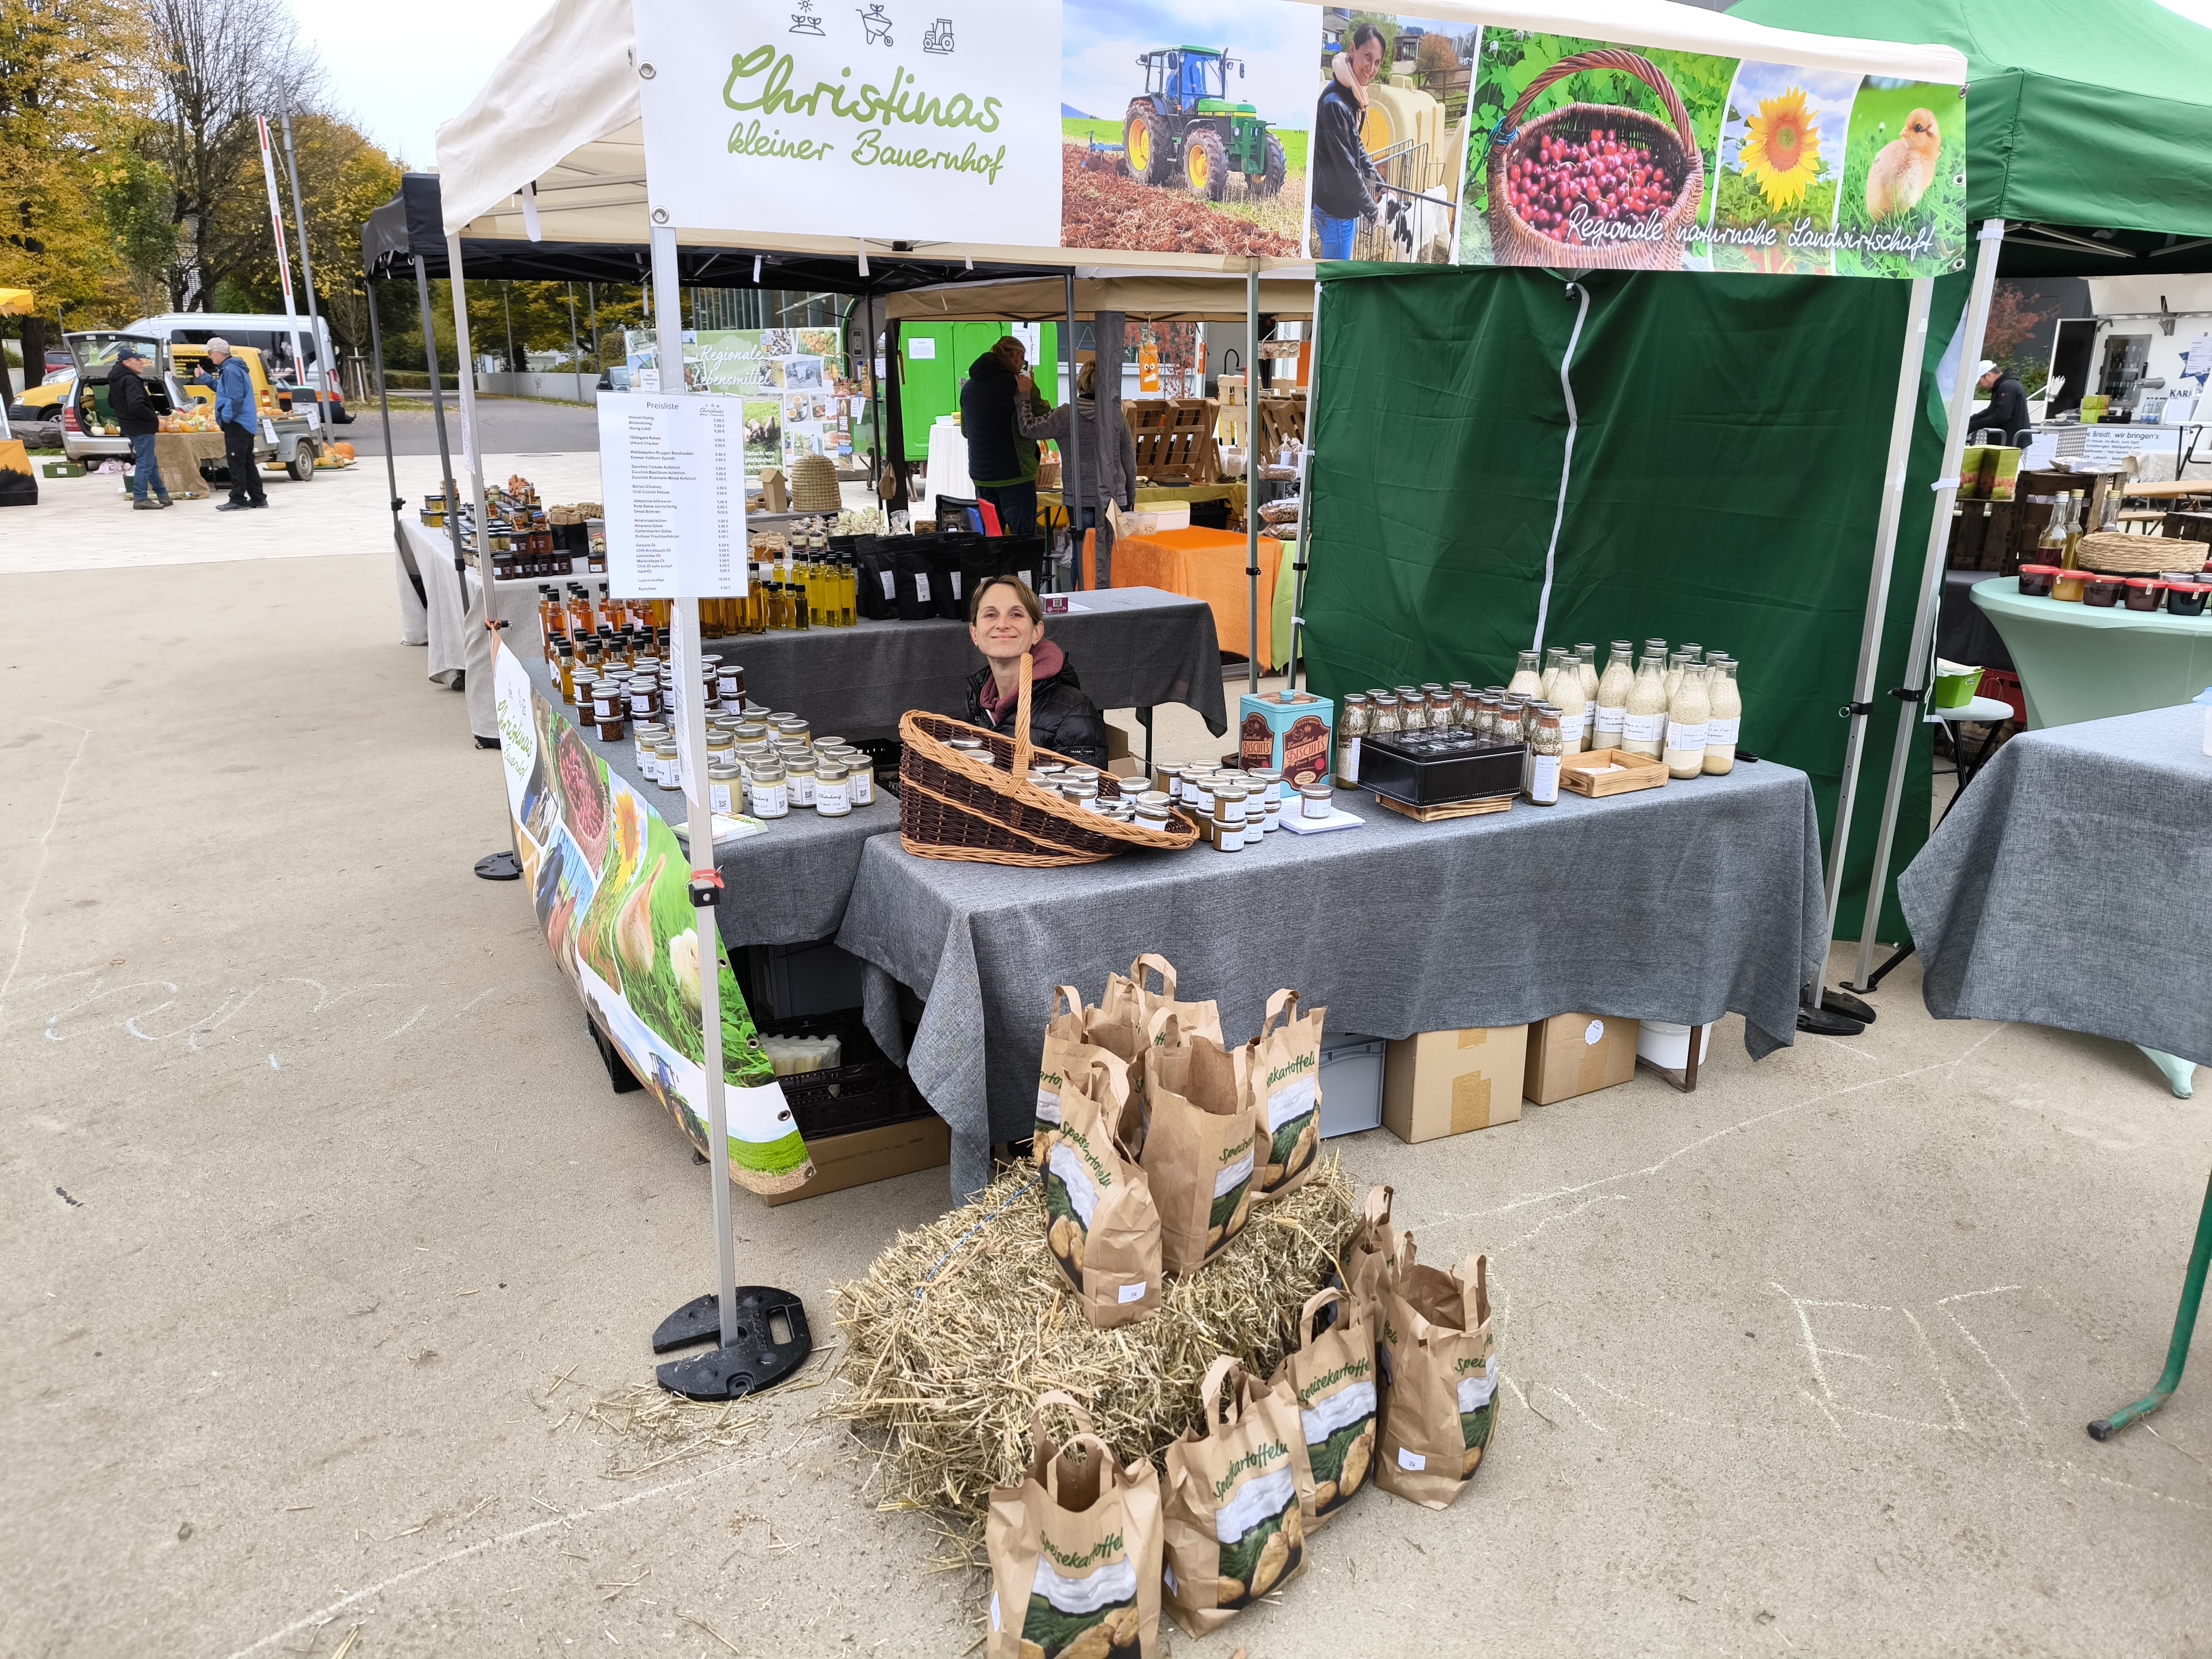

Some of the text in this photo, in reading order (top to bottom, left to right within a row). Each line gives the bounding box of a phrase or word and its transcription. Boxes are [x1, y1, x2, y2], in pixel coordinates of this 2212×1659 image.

[723, 44, 1002, 133] Christinas
[727, 119, 1006, 185] kleiner Bauernhof
[1568, 204, 1934, 261] Regionale naturnahe Landwirtschaft
[701, 344, 765, 363] Regionale
[693, 368, 771, 387] Lebensmittel
[647, 402, 679, 410] Preisliste
[497, 699, 532, 758] Christinas
[1287, 736, 1314, 748] Excellent
